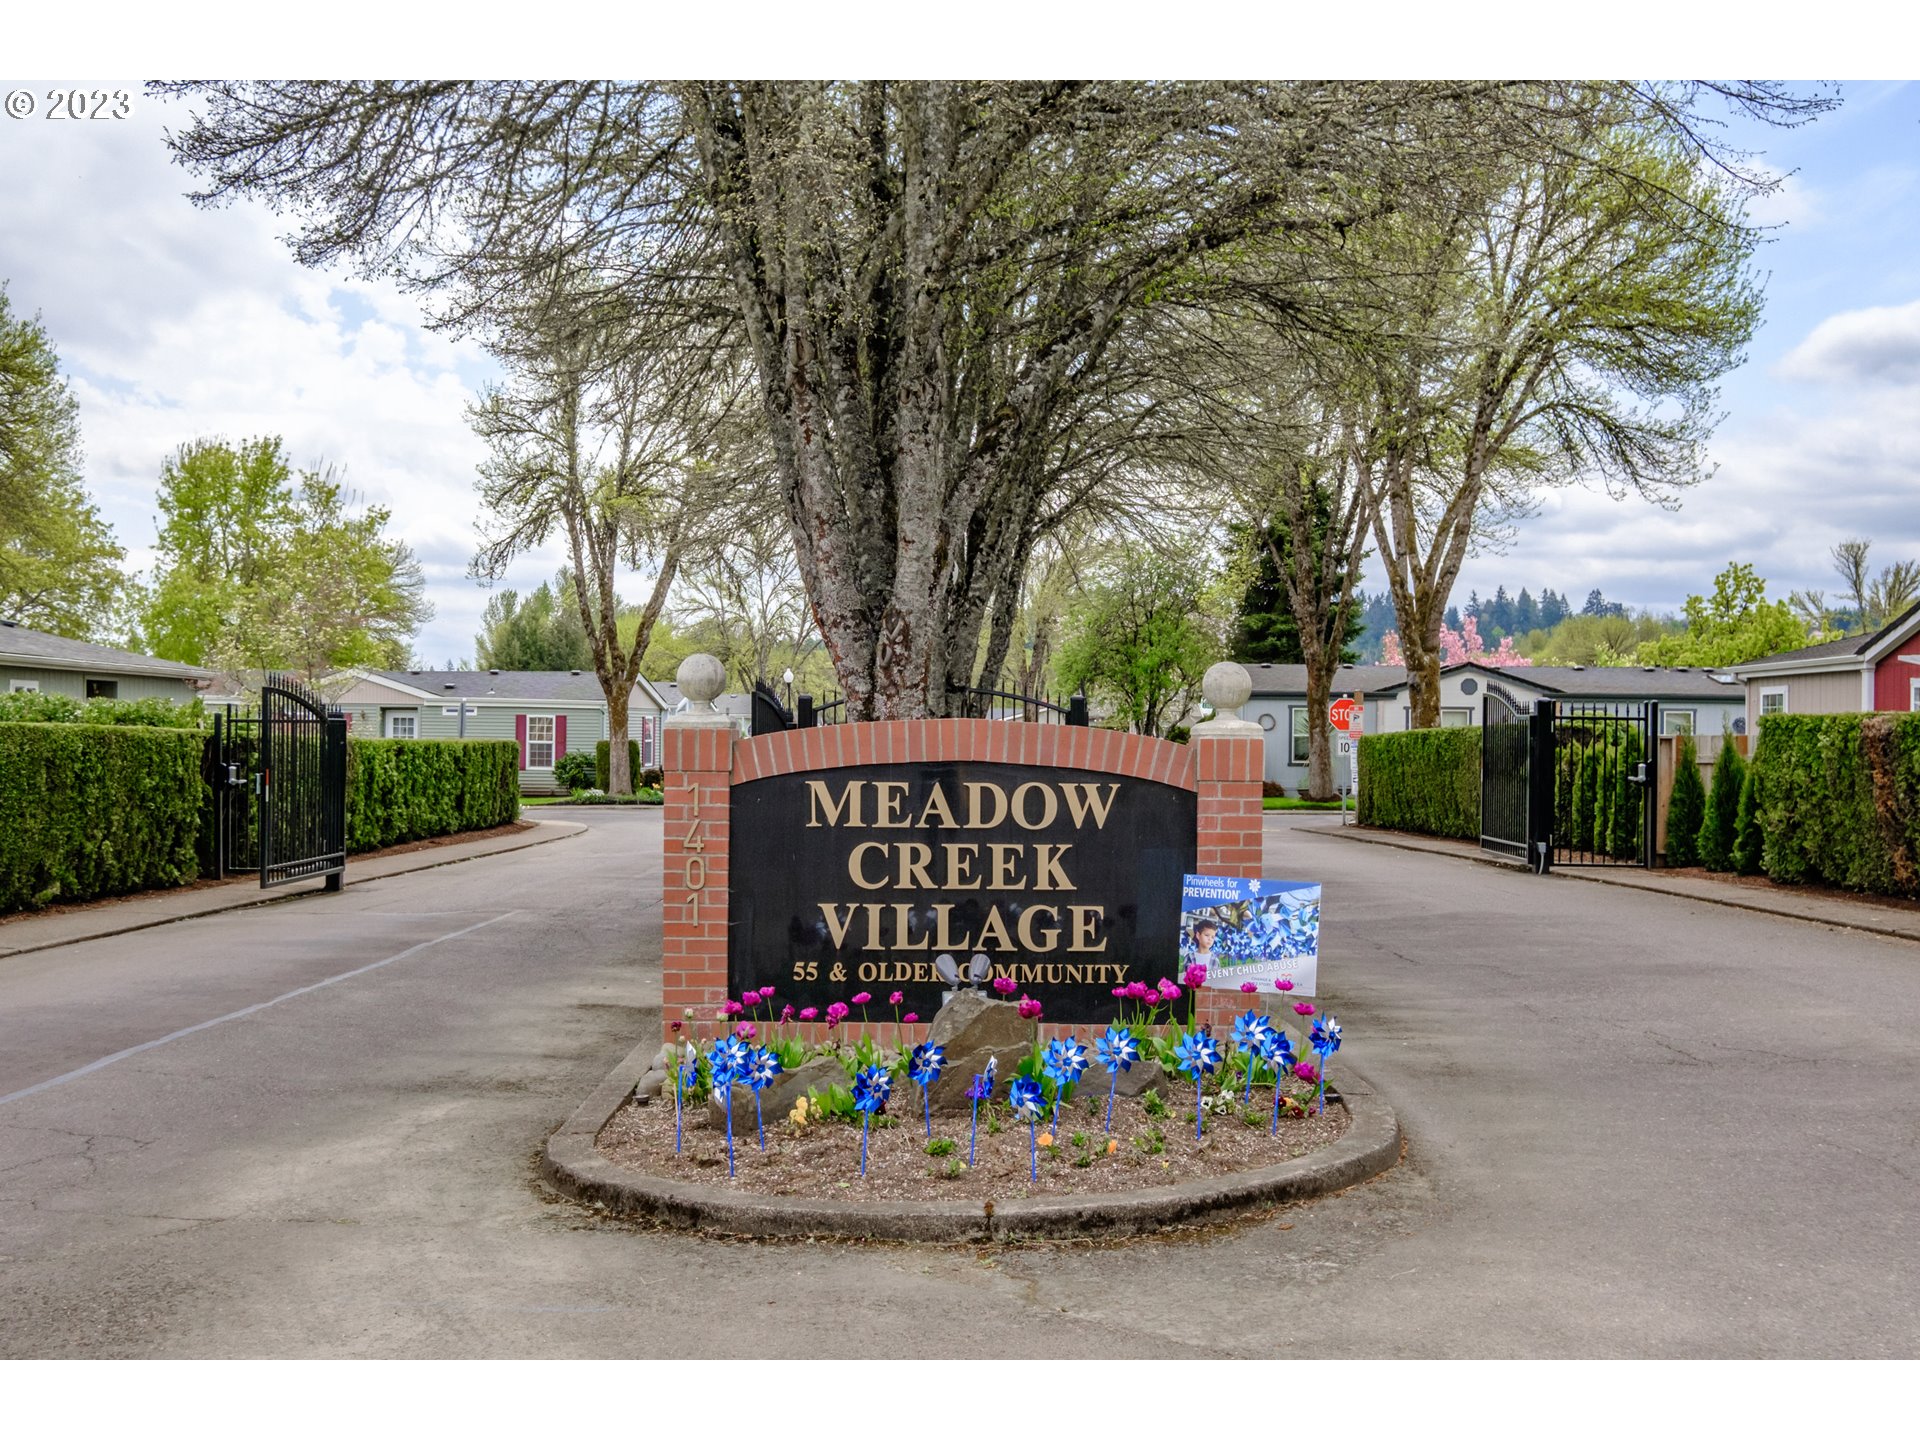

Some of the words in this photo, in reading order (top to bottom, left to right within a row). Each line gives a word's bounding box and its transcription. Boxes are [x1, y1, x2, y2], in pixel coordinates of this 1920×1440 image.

[1331, 709, 1349, 721] STO
[1340, 742, 1350, 753] 10
[805, 780, 1121, 830] MEADOW
[683, 782, 705, 928] 1401
[848, 841, 1077, 890] CREEK
[1186, 874, 1224, 888] Pinwheels
[1227, 877, 1238, 888] for
[1183, 886, 1240, 900] PREVENTION
[817, 903, 1107, 952] VILLAGE
[793, 961, 819, 981] 55
[829, 961, 847, 982] &
[1206, 967, 1234, 980] EVENT
[1236, 963, 1264, 976] CHILD
[1267, 960, 1298, 972] ABUSE
